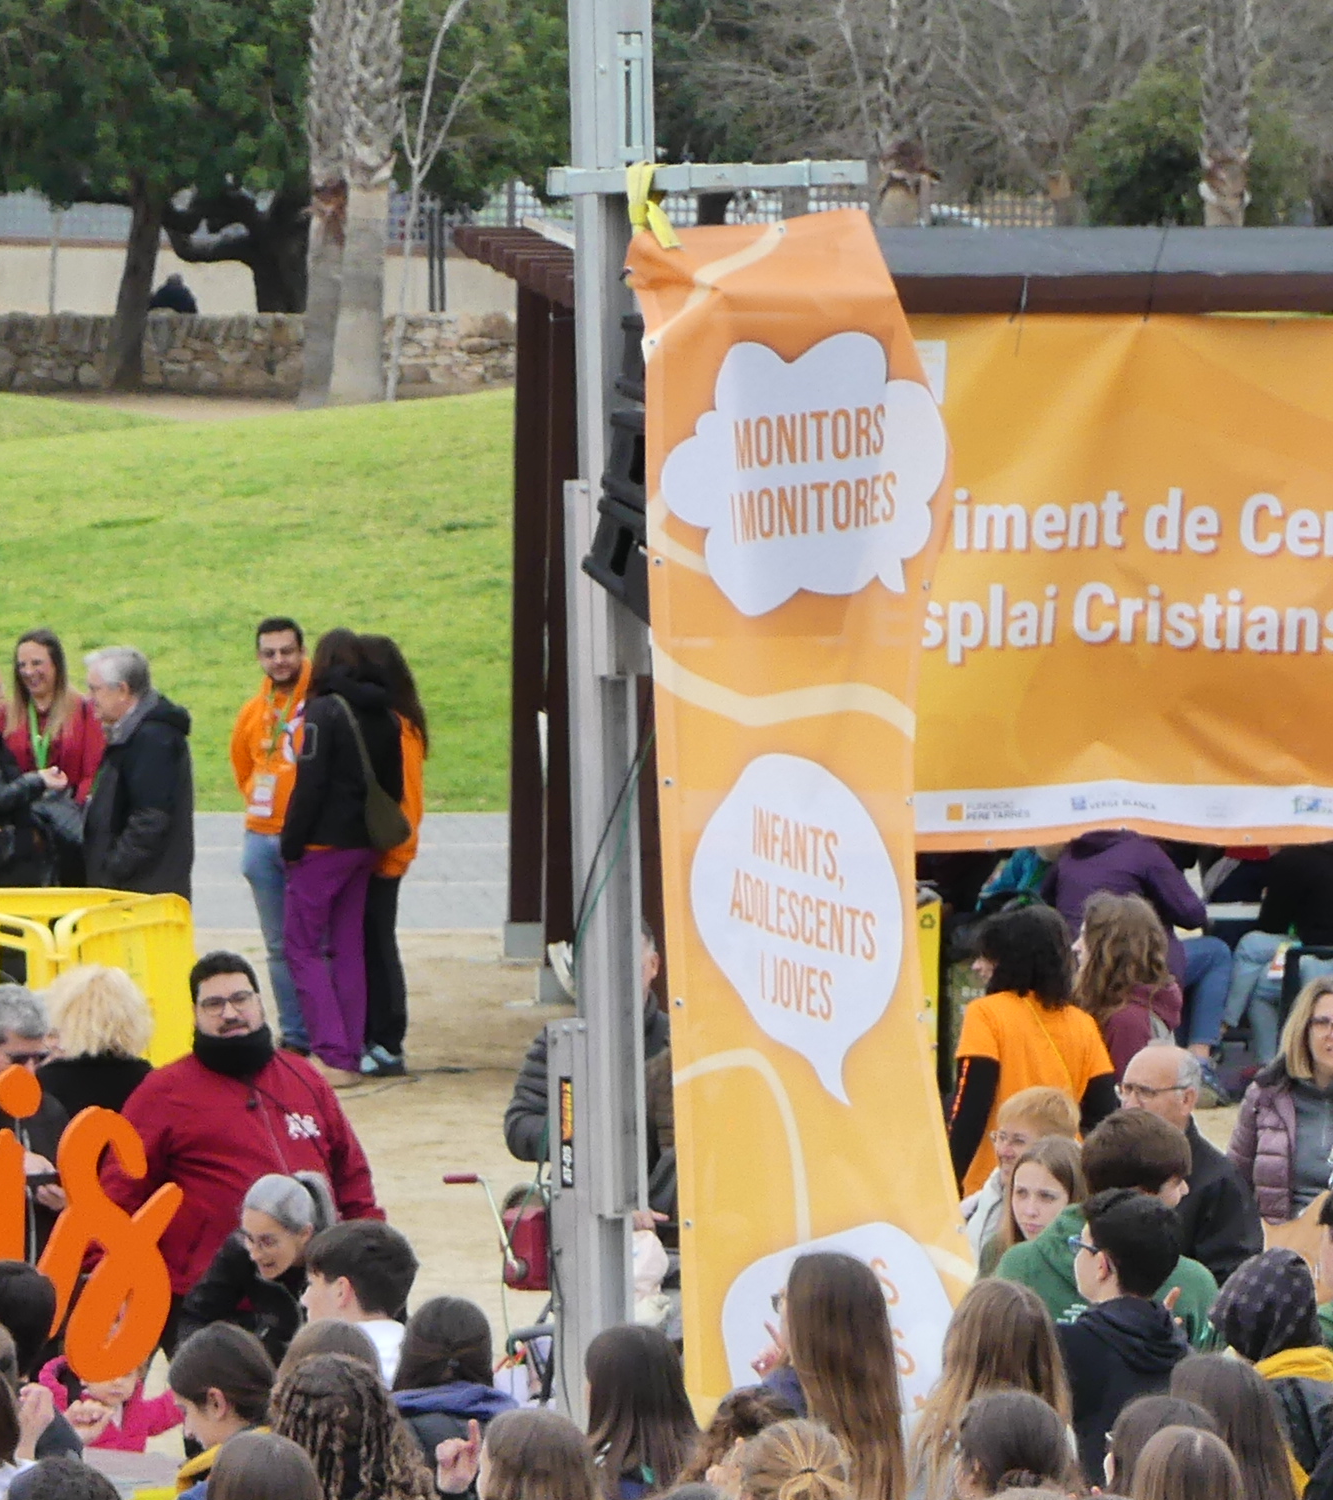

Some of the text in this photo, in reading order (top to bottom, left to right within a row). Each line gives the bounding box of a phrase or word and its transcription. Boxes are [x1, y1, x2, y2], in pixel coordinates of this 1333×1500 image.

[733, 404, 887, 471] MONITORS
[738, 473, 898, 540] MONITORES
[952, 487, 1127, 552] iment
[1143, 486, 1220, 553] de
[921, 583, 1060, 665] splai
[751, 805, 846, 890] INFANTS,
[729, 868, 877, 962] ADOLESCENTS
[769, 960, 833, 1022] JOVES
